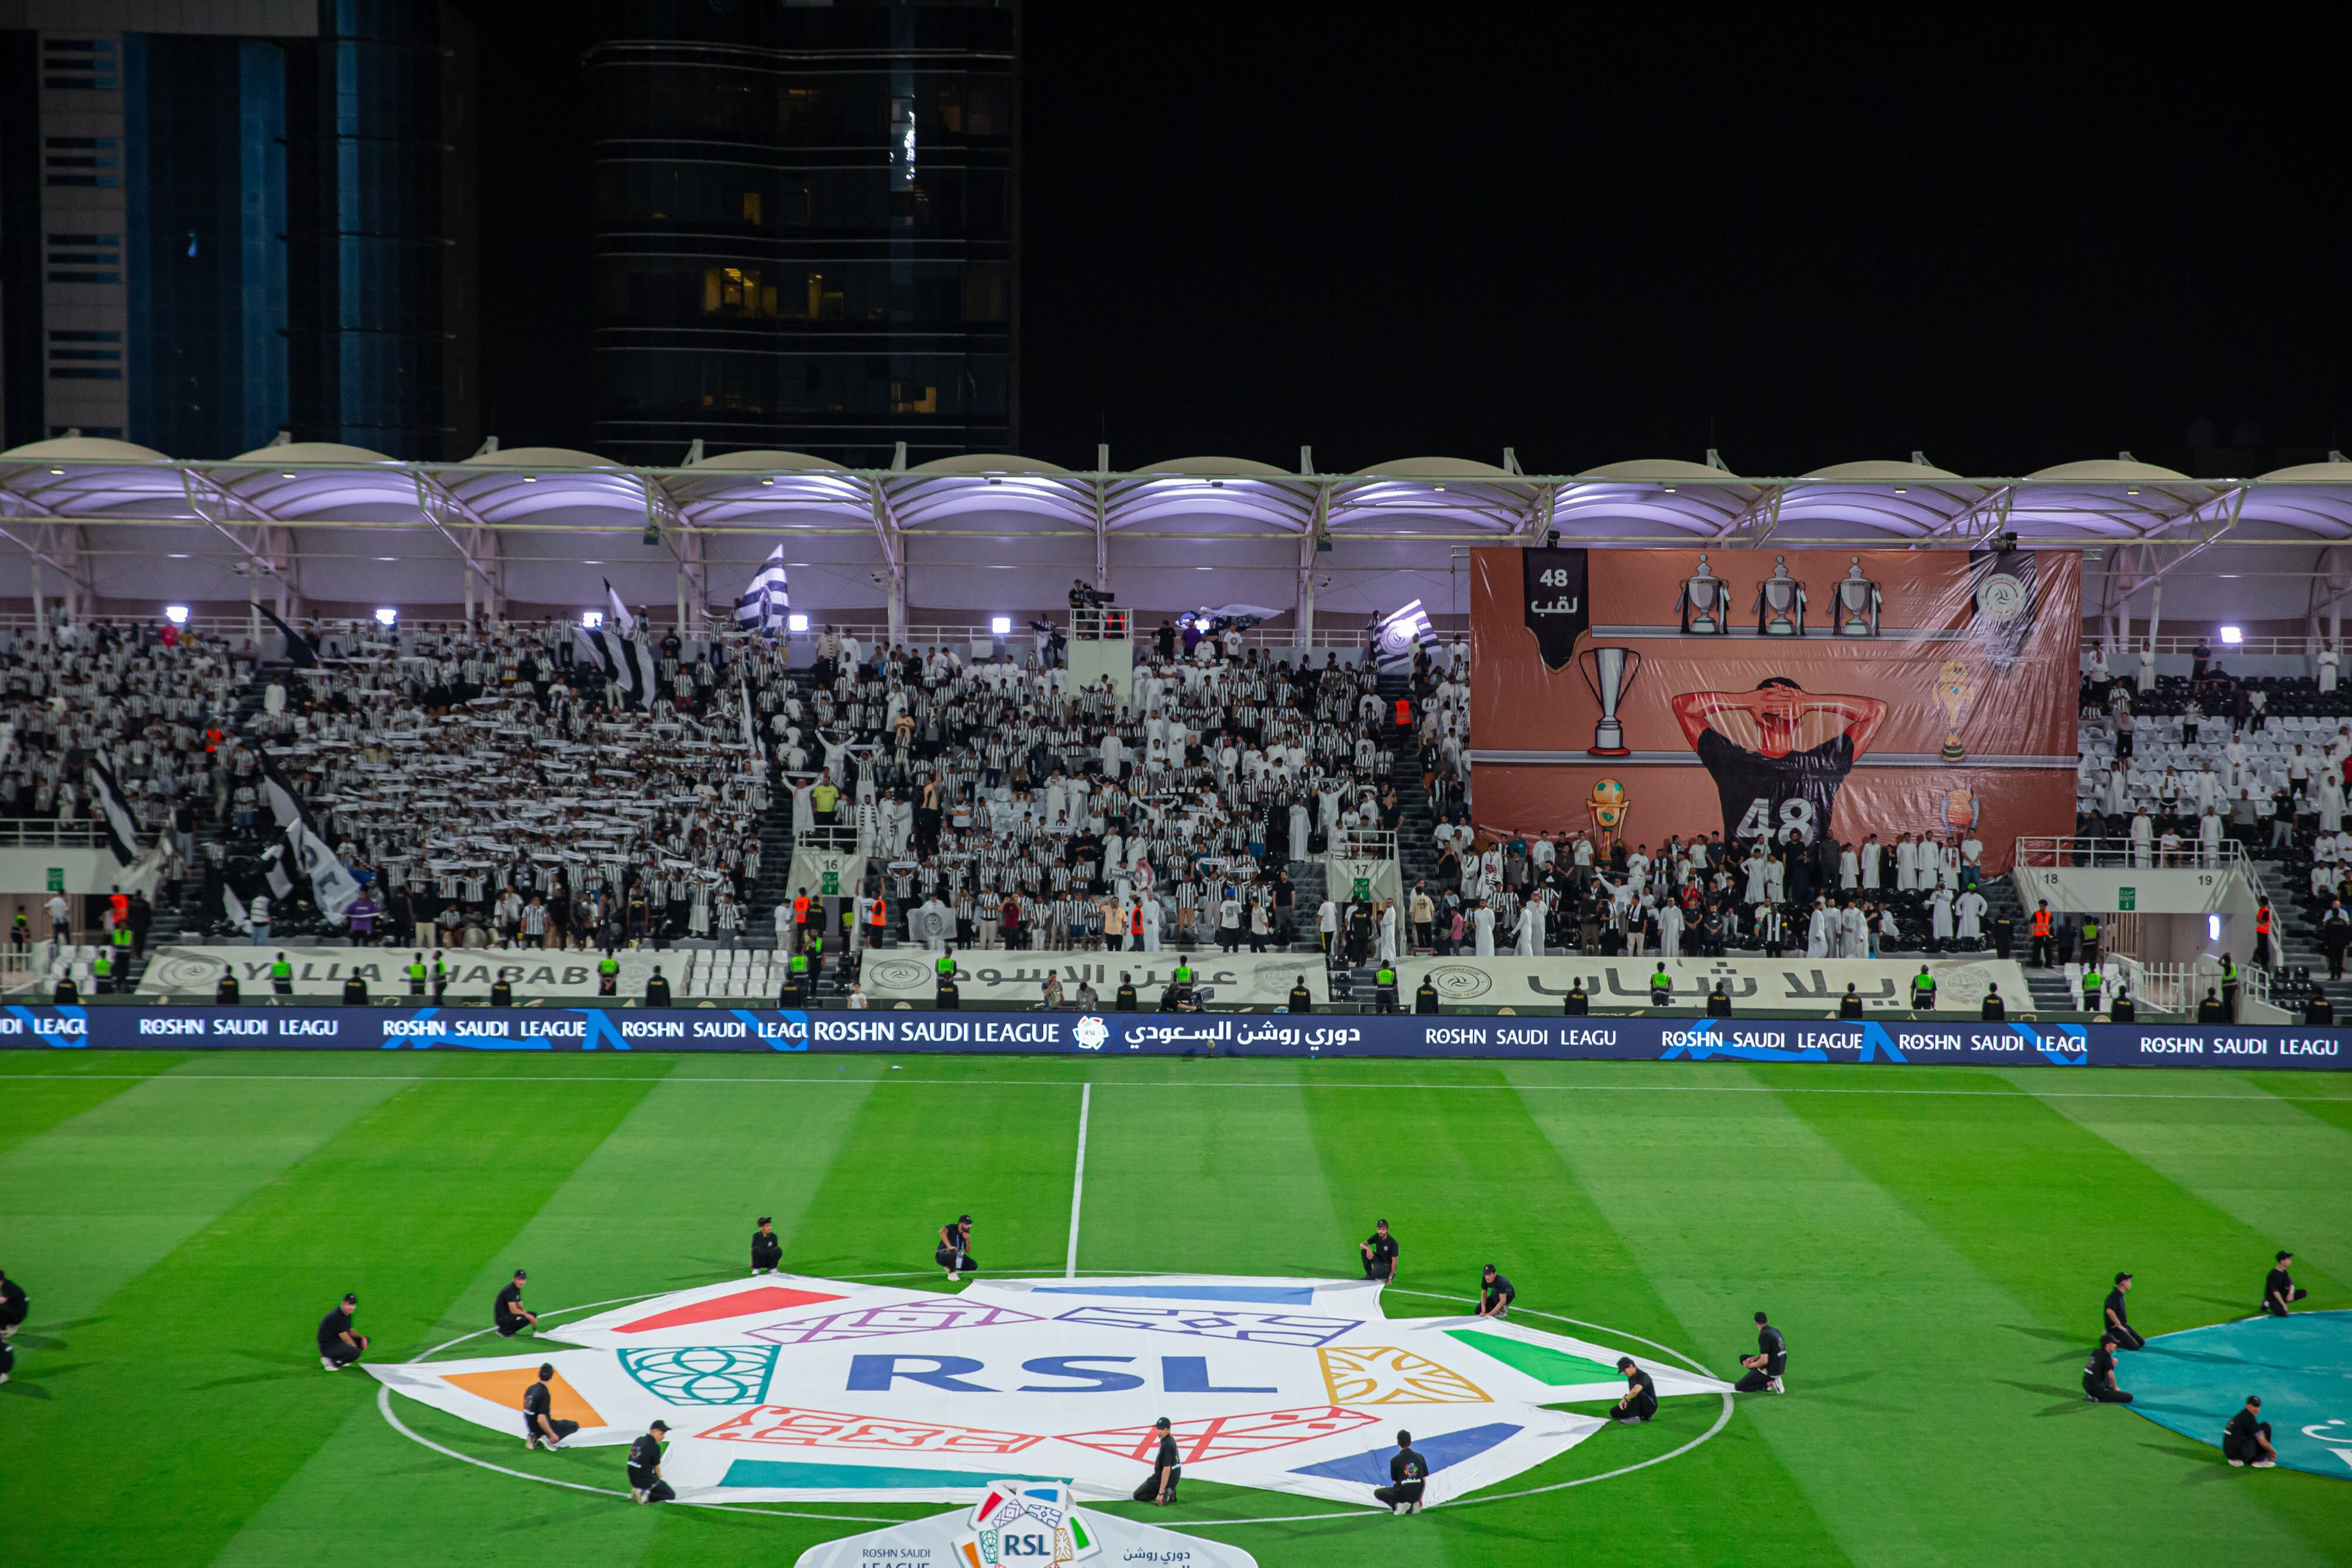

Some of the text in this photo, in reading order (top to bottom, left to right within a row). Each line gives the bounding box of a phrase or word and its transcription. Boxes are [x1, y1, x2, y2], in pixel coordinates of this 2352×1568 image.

[1539, 569, 1568, 587] 48
[1531, 596, 1578, 617] لقب
[1736, 798, 1813, 848] 48
[823, 860, 837, 870] 16
[1354, 864, 1368, 875] 17
[2044, 874, 2057, 884] 18
[2198, 875, 2212, 885] 19
[243, 962, 382, 982] YLLA
[1782, 969, 1900, 1006] يلا
[140, 1018, 338, 1035] ROSHN SAUDI LEAGU
[383, 1020, 586, 1037] ROSHN SAUDI LEAGUE
[622, 1021, 684, 1037] ROSHN
[693, 1022, 746, 1037] SAUDI
[814, 1021, 1059, 1042] ROSHN SAUDI LEAGUE
[1124, 1021, 1360, 1051] دوري روشن السعودي
[1426, 1028, 1616, 1045] ROSHN SAUDI LEAGU
[1662, 1031, 1863, 1049] ROSHN SAUDI LEAGUE
[1899, 1034, 1961, 1050] ROSHN
[1970, 1035, 2023, 1051] SAUDI
[2140, 1037, 2338, 1055] ROSHN SAUDI LEAGU
[846, 1354, 1278, 1393] RSL
[863, 1548, 930, 1558] ROSHN SAUDI
[1004, 1534, 1051, 1556] RSL
[1123, 1547, 1191, 1564] دوري روشن
